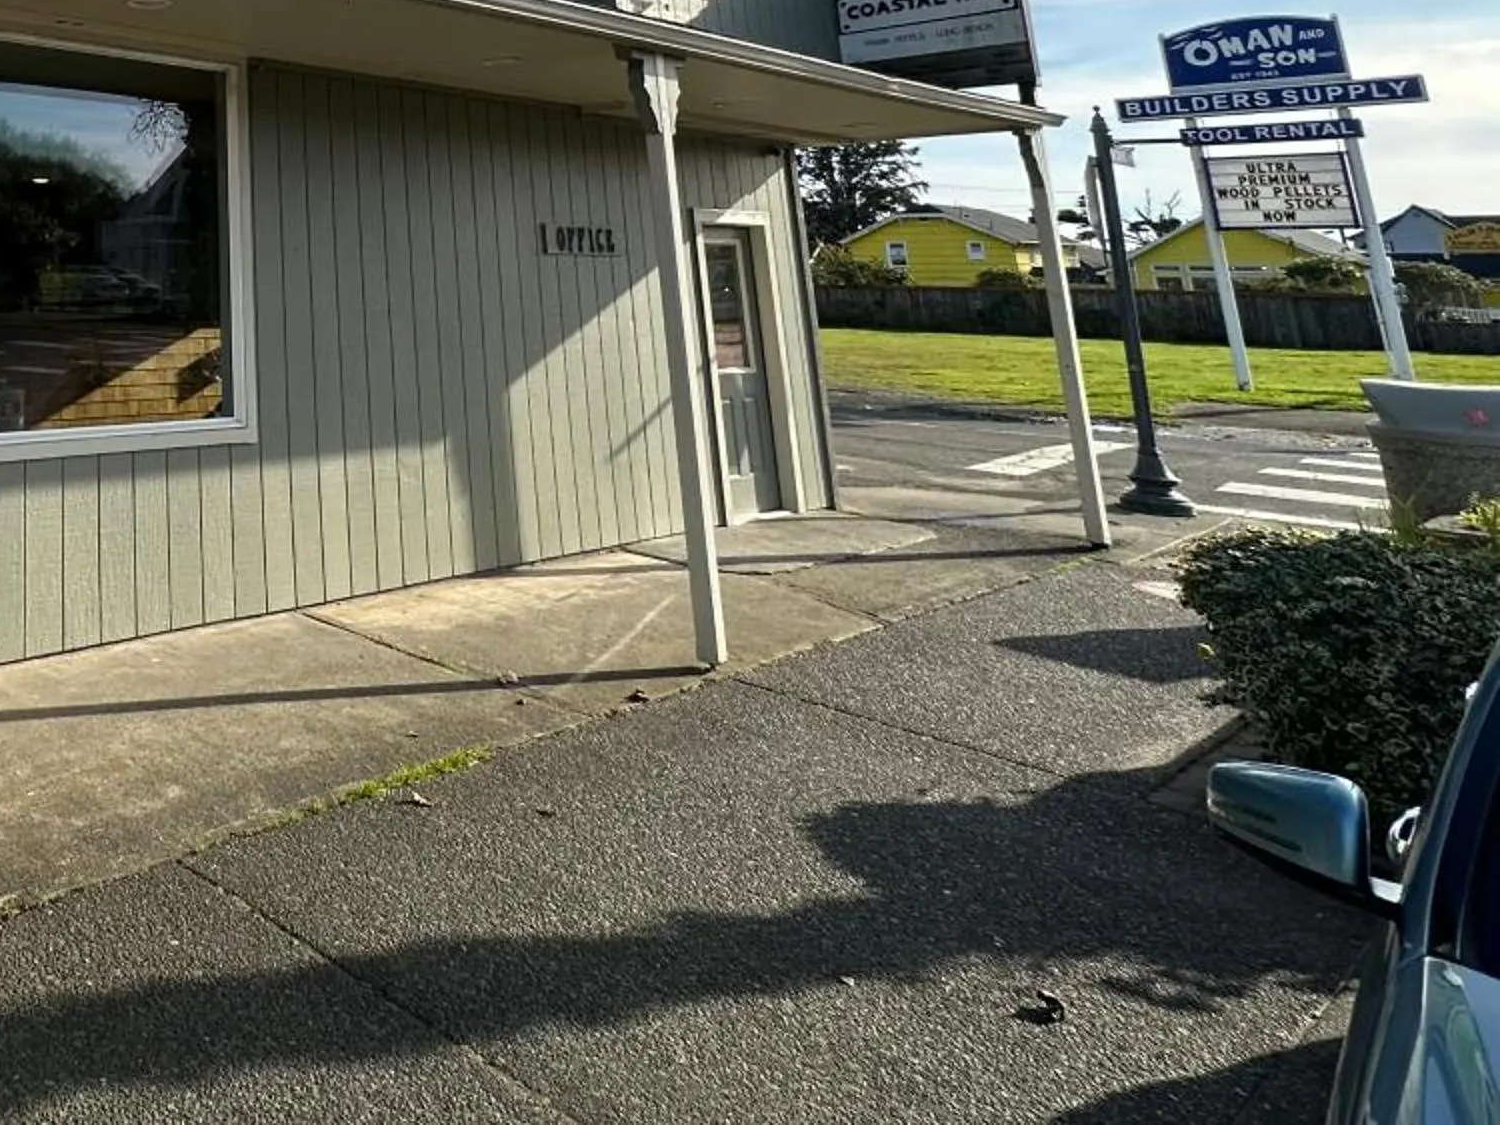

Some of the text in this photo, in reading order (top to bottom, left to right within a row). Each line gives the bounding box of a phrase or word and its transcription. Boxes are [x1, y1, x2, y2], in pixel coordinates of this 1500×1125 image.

[1299, 28, 1325, 40] AND
[1184, 25, 1293, 66] OMAN
[1257, 48, 1316, 68] SON
[1125, 81, 1408, 116] BUILDERS SUPPLY
[1254, 122, 1354, 139] RENTAL
[1245, 161, 1297, 173] ULTRA
[1238, 173, 1311, 185] PREMIUM
[1217, 185, 1342, 198] WOOD PELLETS
[1244, 198, 1336, 211] IN STOCK
[1262, 211, 1297, 222] NOW
[556, 226, 615, 253] OFFICE
